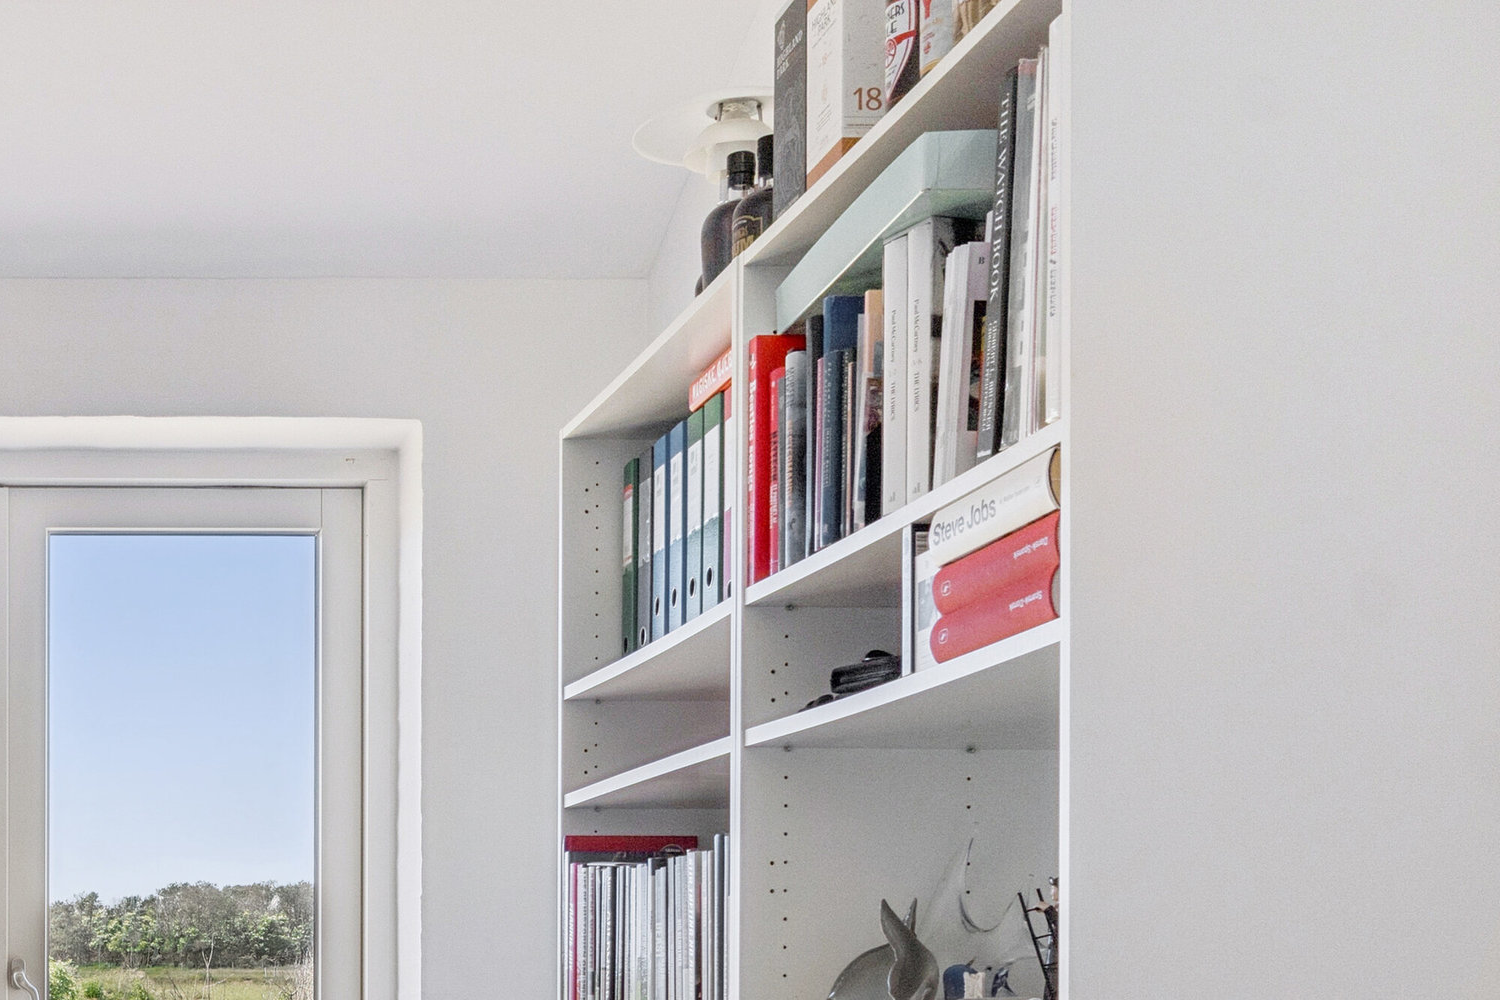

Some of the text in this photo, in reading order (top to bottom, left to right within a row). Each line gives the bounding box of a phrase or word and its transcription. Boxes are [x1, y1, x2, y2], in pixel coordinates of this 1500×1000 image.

[853, 87, 882, 111] 18
[989, 92, 1010, 303] THE WATCH BOOK
[748, 379, 757, 441] Beatles
[747, 445, 755, 492] songs
[933, 500, 997, 545] Steve Jobs
